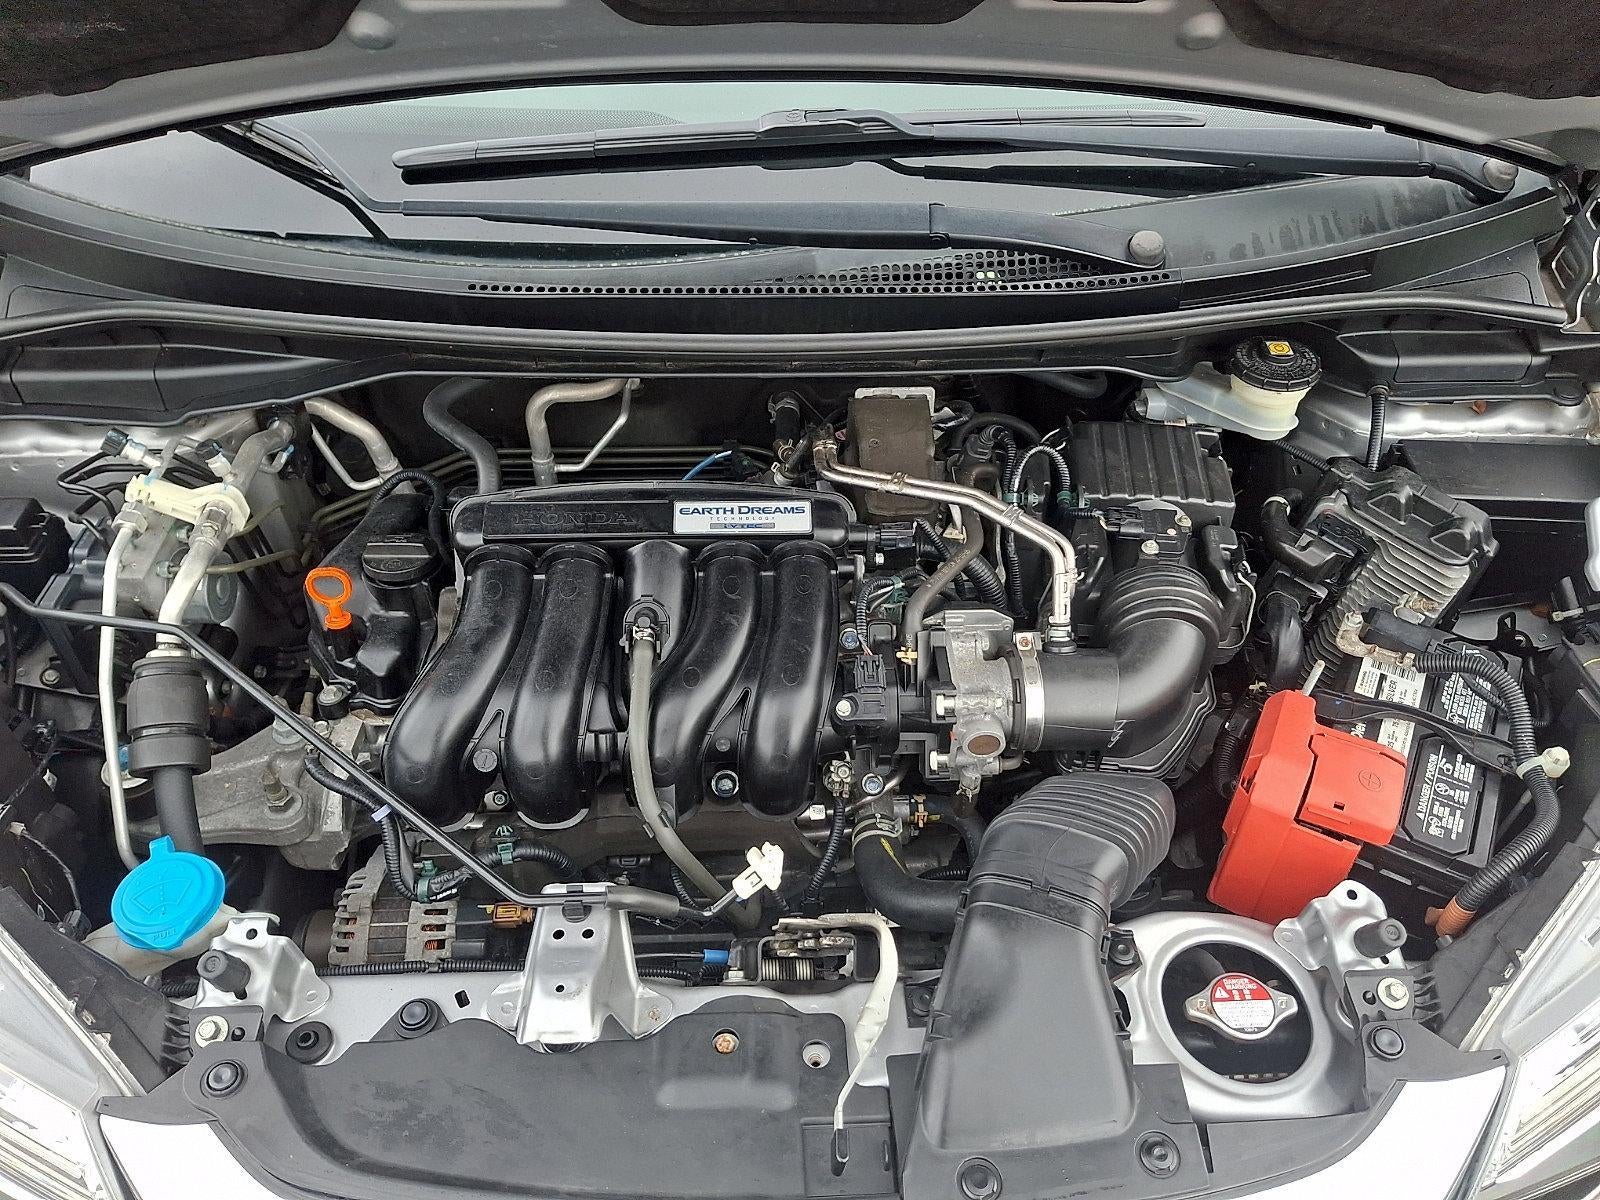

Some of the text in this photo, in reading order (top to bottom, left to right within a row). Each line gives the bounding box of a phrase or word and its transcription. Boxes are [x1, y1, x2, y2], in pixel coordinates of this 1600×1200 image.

[679, 505, 805, 515] EARTH DREAMS
[515, 511, 638, 526] HONDA
[1417, 783, 1431, 814] DANGER
[1425, 752, 1438, 779] POISON
